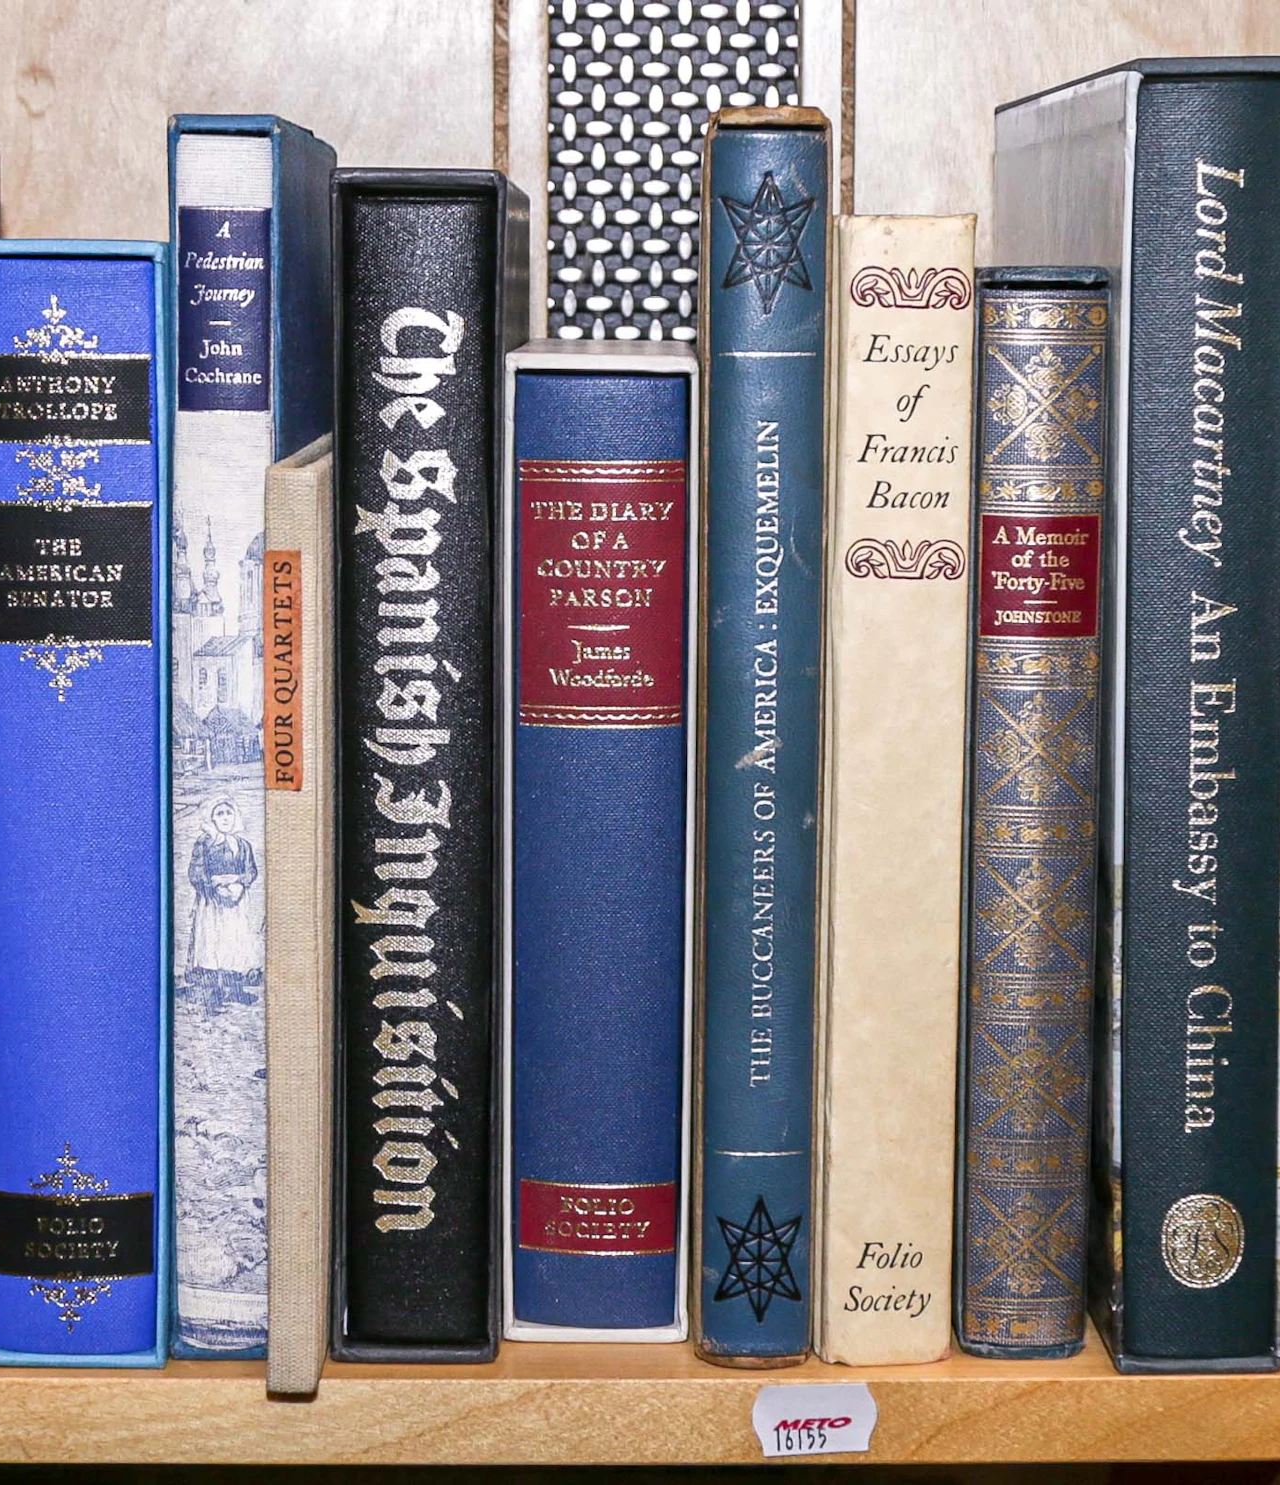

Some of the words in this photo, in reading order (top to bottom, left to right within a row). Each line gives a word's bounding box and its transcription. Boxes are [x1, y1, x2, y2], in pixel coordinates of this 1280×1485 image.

[215, 220, 232, 239] A
[1195, 157, 1246, 285] Lord
[183, 251, 264, 271] Pedestrian
[191, 283, 256, 308] Journey
[198, 338, 244, 359] John
[863, 334, 959, 371] Essays
[183, 366, 263, 387] Cochrane
[372, 306, 466, 430] The
[896, 385, 927, 422] of
[1178, 295, 1243, 569] Macartney
[857, 433, 959, 465] Francis
[866, 482, 950, 511] Bacon
[530, 500, 583, 520] THE
[589, 500, 674, 522] DIARY
[755, 419, 783, 614] EXQUEMELIN
[34, 537, 83, 556] THE
[571, 530, 607, 550] OF
[612, 531, 629, 550] A
[993, 527, 1010, 545] A
[1016, 527, 1089, 547] Memoir
[536, 558, 667, 579] COUNTRY
[1011, 550, 1034, 568] of
[1039, 550, 1070, 568] the
[7, 589, 114, 608] SENATOR
[354, 446, 463, 767] Spanish
[548, 588, 653, 608] PARSON
[995, 609, 1081, 625] JOHNSTONE
[1189, 590, 1239, 665] An
[273, 559, 295, 707] QUARTETS
[570, 638, 631, 665] James
[548, 667, 655, 688] Woodforde
[754, 640, 779, 775] AMERICA
[274, 718, 296, 785] FOUR
[753, 781, 777, 821] OF
[1171, 679, 1238, 904] Embassy
[751, 828, 775, 1020] BUCCANEERS
[1187, 922, 1224, 969] to
[350, 771, 466, 1234] Inquisition
[750, 1027, 773, 1088] THE
[1185, 984, 1234, 1134] China
[560, 1196, 635, 1216] FOLIO
[36, 1216, 105, 1236] FOLIO
[544, 1220, 650, 1241] SOCIETY
[24, 1239, 120, 1261] SOCIETY
[856, 1240, 924, 1271] Folio
[843, 1283, 932, 1316] Society
[773, 1415, 853, 1431] METO
[774, 1427, 827, 1452] 16155
